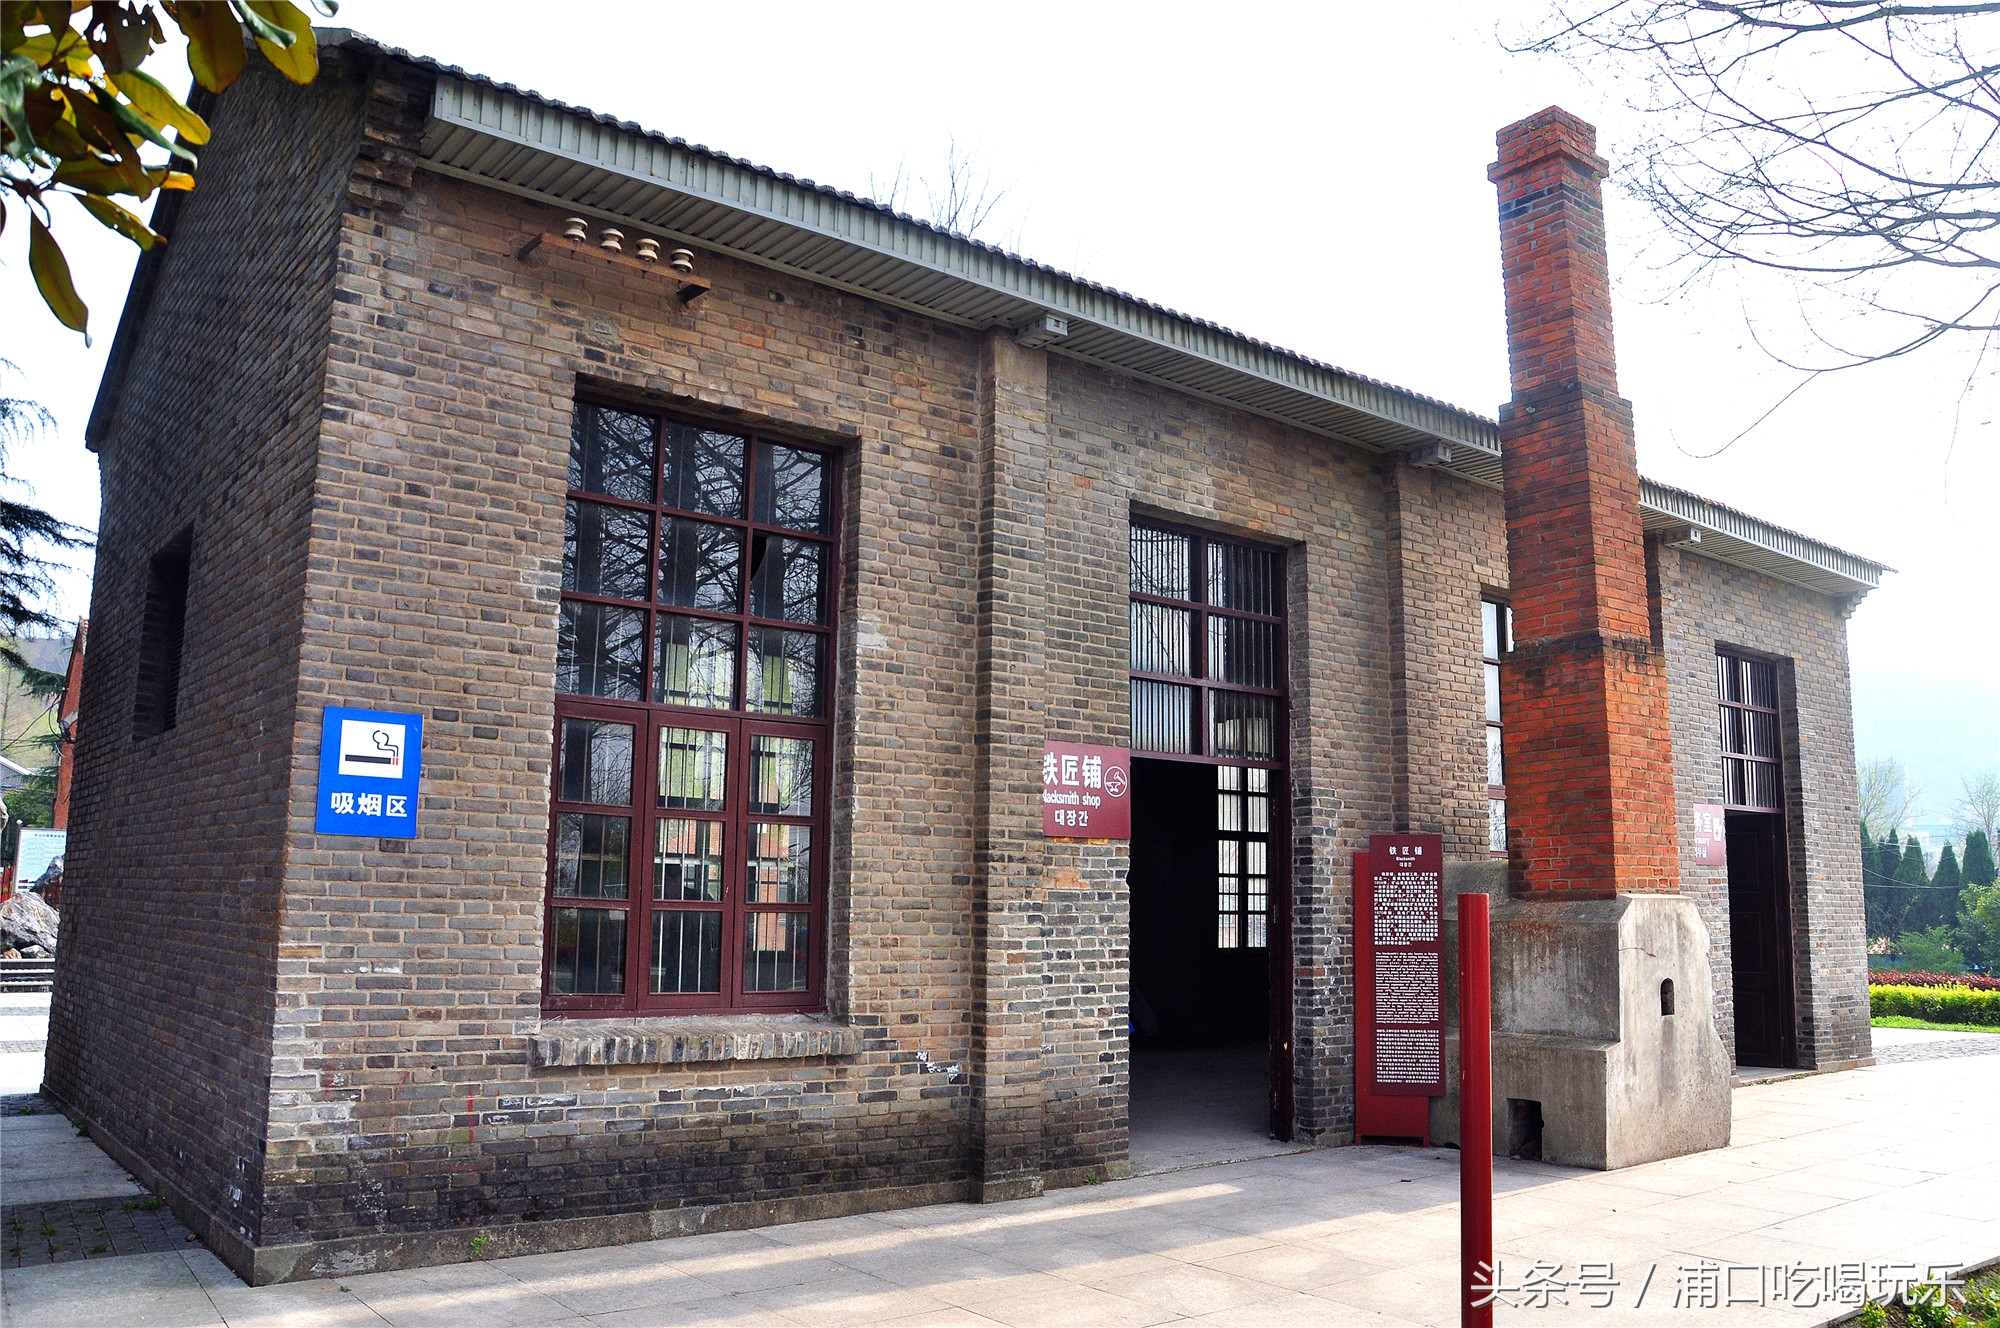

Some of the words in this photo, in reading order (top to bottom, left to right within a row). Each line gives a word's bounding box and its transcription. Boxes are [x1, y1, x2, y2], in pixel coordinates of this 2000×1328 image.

[1042, 752, 1102, 789] 铁匠铺
[330, 792, 408, 818] 吸烟区
[1082, 792, 1101, 809] shop
[1054, 809, 1089, 827] 대장간
